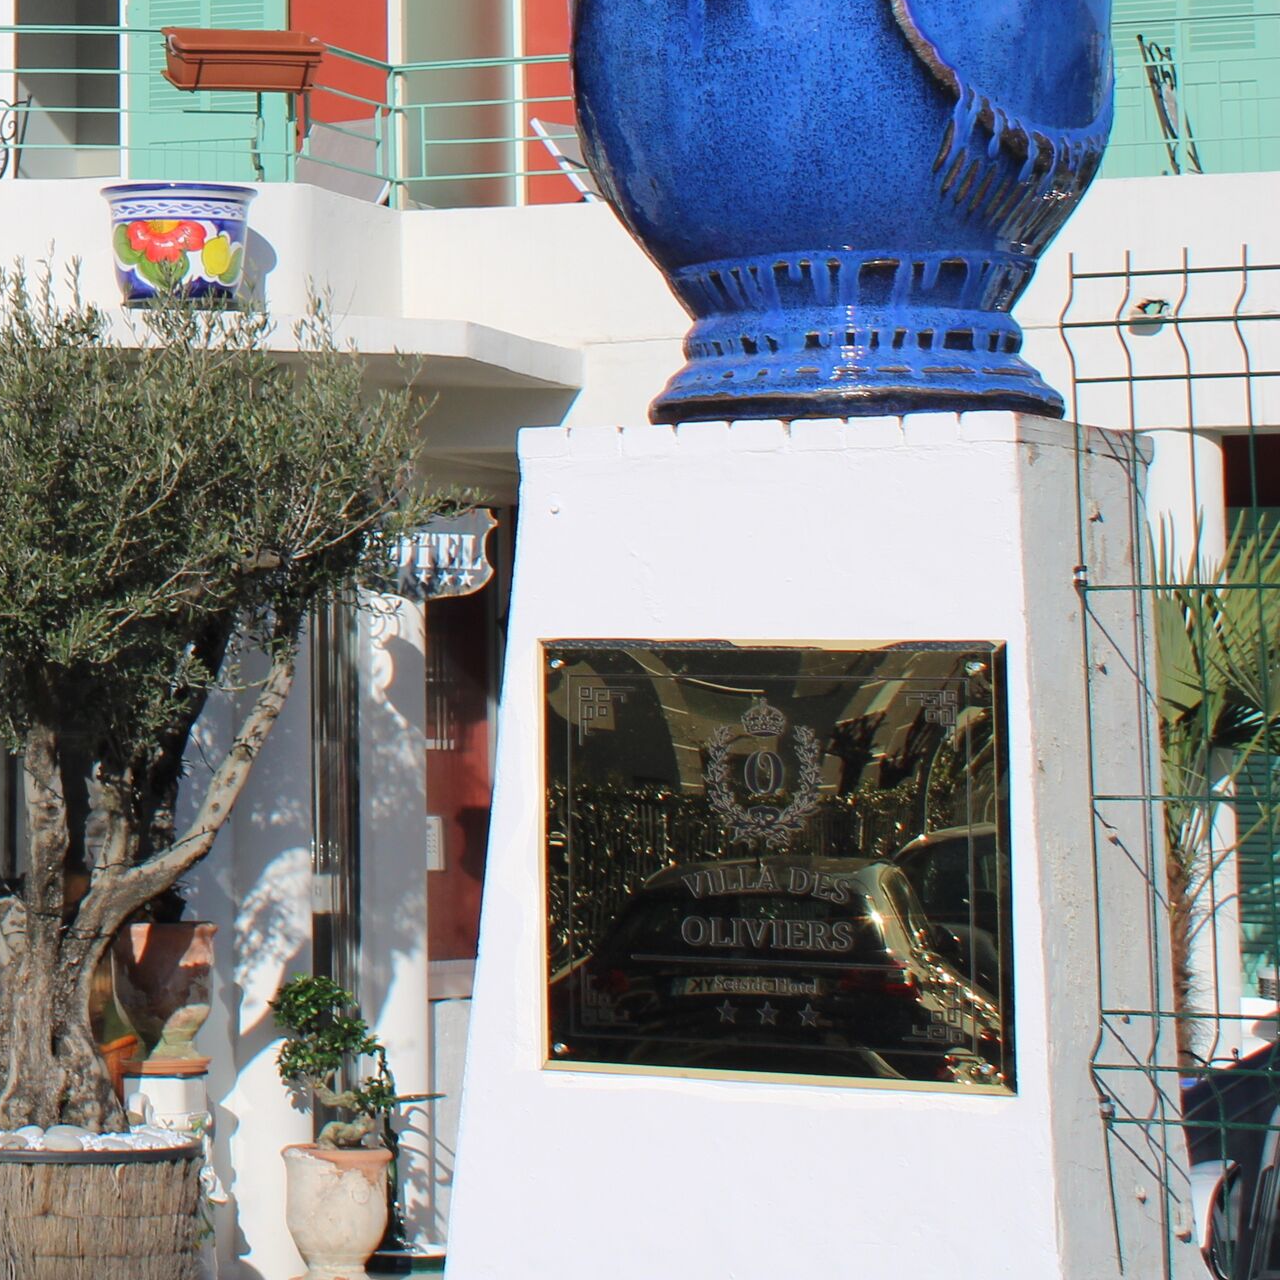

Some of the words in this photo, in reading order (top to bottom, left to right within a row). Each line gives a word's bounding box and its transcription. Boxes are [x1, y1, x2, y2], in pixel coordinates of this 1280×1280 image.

[680, 864, 781, 900] VILLA
[788, 867, 851, 904] DES
[680, 915, 855, 953] OLIVIERS
[713, 975, 769, 994] Seaside
[774, 976, 818, 995] Hotel
